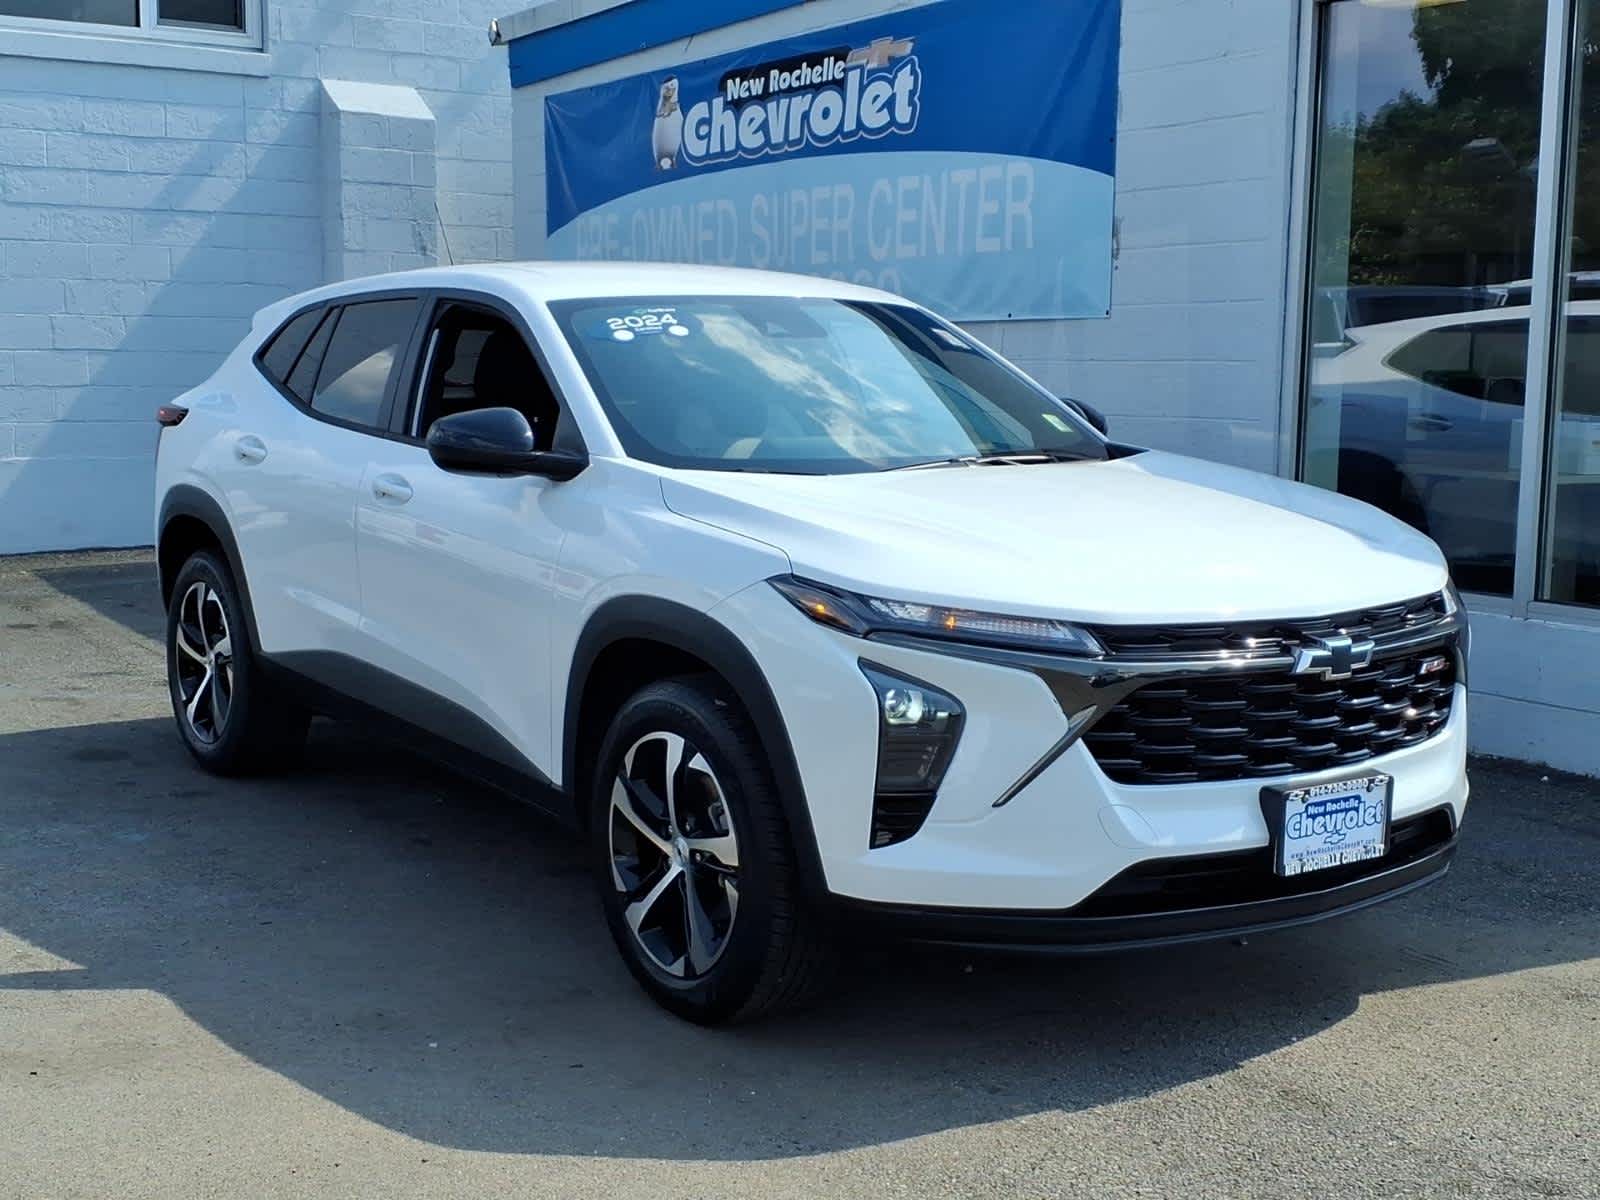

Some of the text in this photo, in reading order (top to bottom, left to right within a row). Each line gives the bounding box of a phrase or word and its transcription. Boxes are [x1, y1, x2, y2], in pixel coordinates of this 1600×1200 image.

[726, 56, 845, 101] New Rochelle
[683, 64, 916, 158] Chevrolet
[576, 161, 1035, 268] PRE-OWNED SUPER CENTER
[606, 312, 678, 330] 2024
[1287, 801, 1384, 839] Chevrolet
[1308, 797, 1359, 815] New Rochelle
